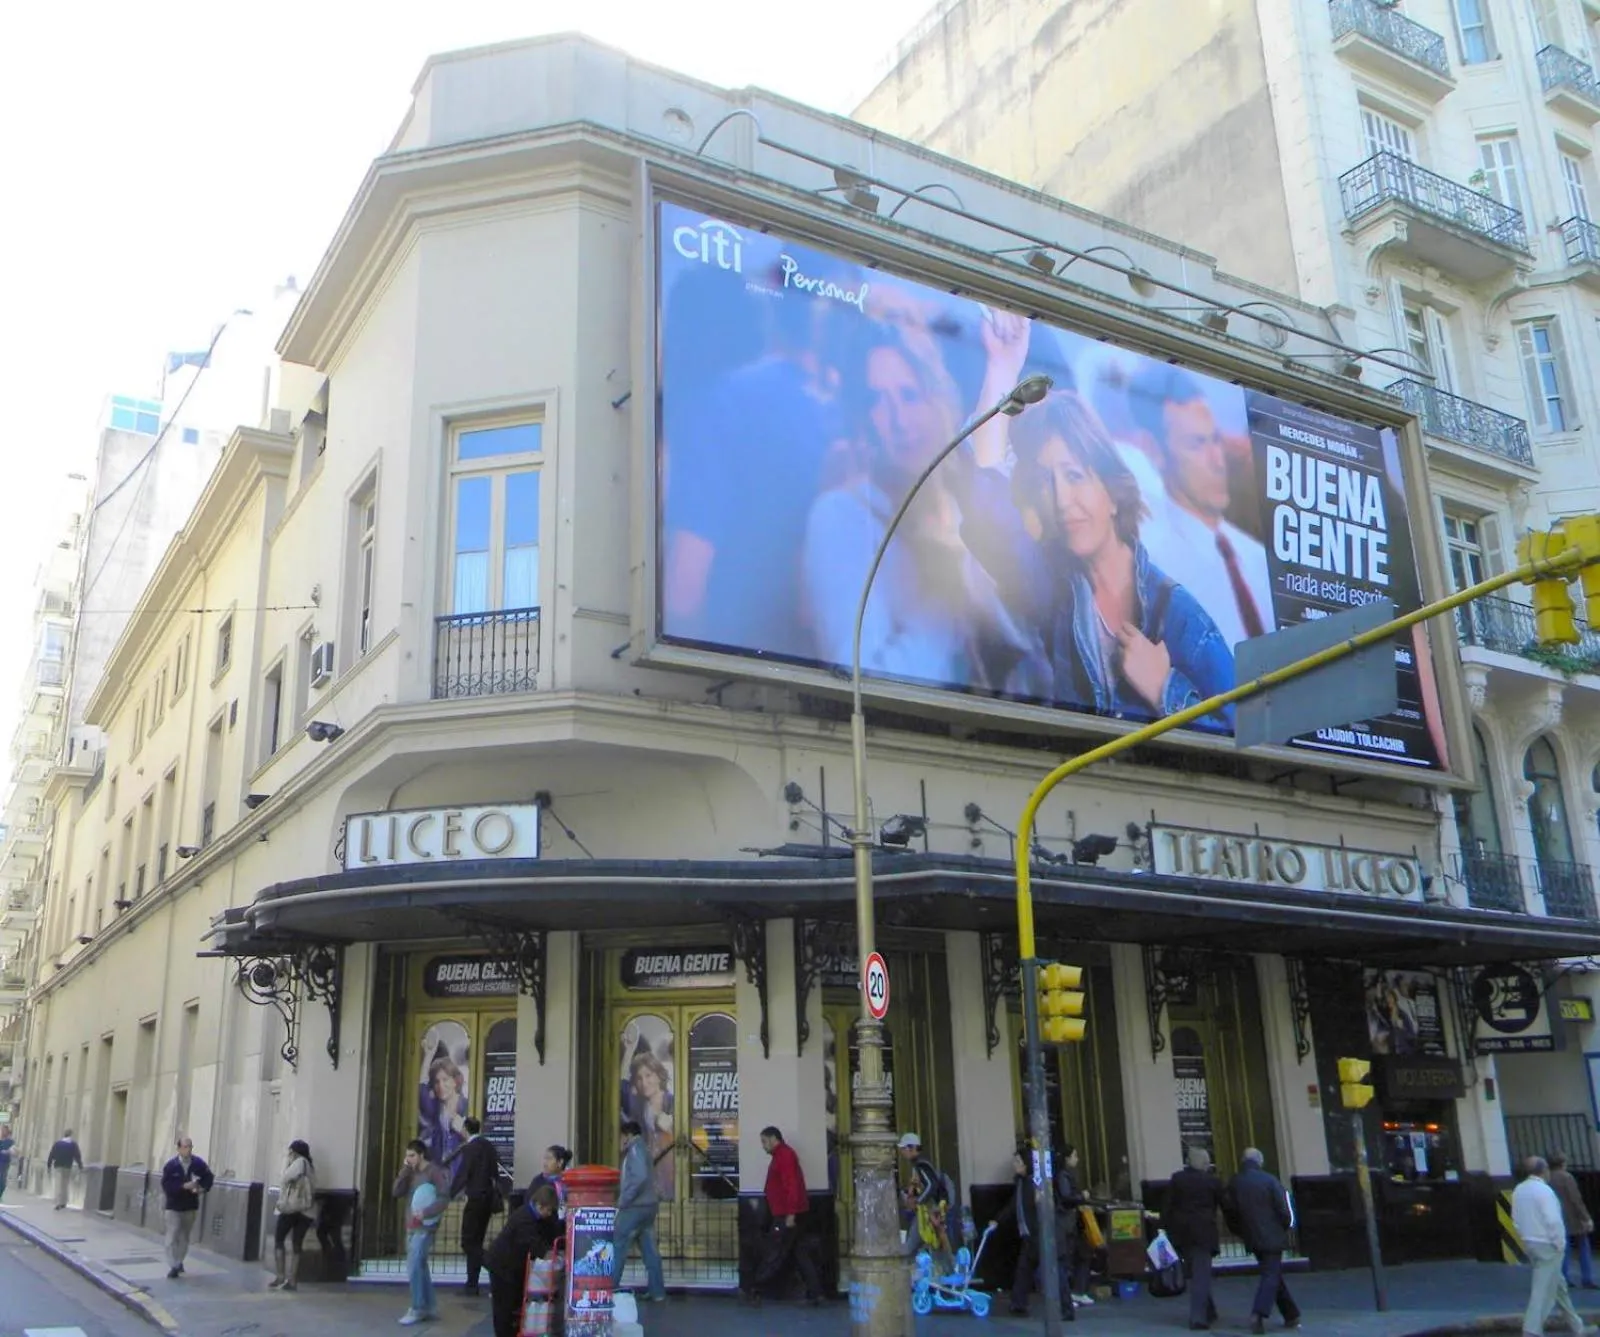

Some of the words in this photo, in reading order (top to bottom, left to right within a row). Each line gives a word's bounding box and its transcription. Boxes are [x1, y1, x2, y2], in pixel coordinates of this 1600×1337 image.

[673, 219, 742, 273] citi
[780, 254, 868, 313] Personal
[1279, 423, 1326, 449] MERCEDES
[1266, 445, 1387, 530] BUENA
[1273, 504, 1389, 585] GENTE
[1321, 580, 1347, 603] está
[1316, 727, 1355, 745] CLAUDIO
[359, 809, 515, 864] LICEO
[1161, 830, 1307, 885] TEATRO
[1320, 847, 1416, 896] LICEO
[437, 962, 481, 981] BUENA
[634, 956, 681, 974] BUENA
[682, 953, 730, 972] GENTE
[870, 972, 884, 998] 20
[488, 1077, 516, 1094] BUE
[693, 1072, 739, 1091] BUENA
[693, 1091, 739, 1110] GENTE
